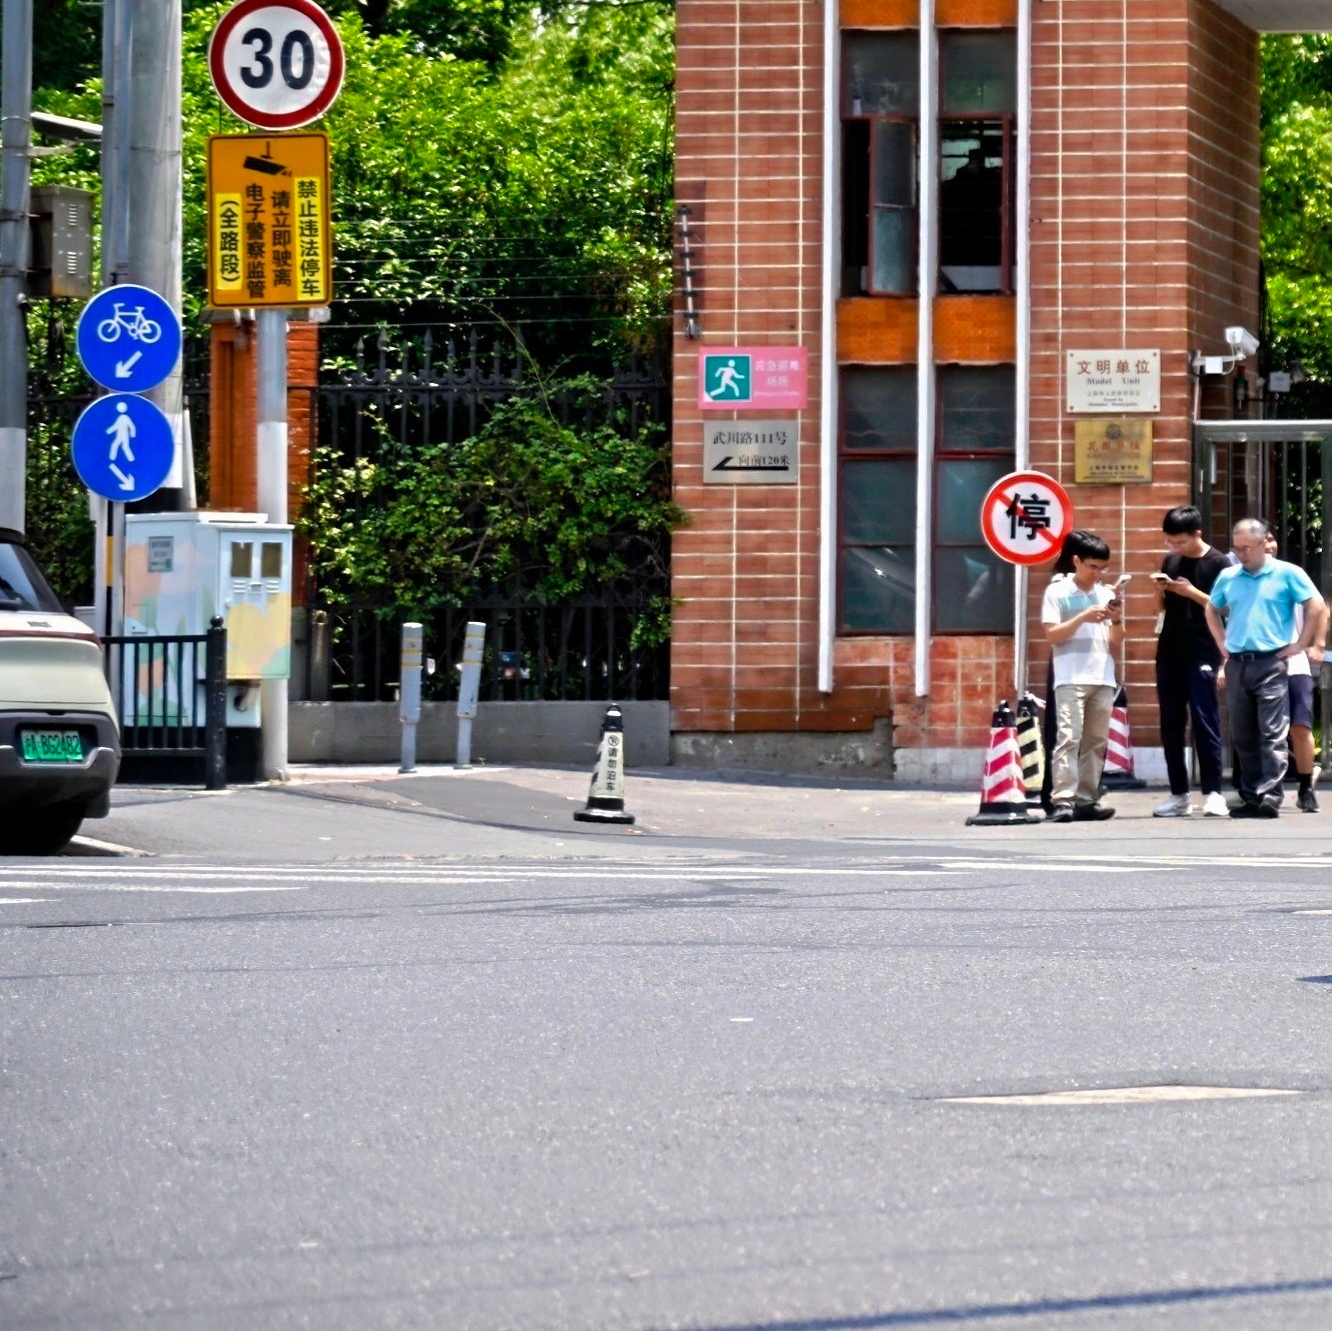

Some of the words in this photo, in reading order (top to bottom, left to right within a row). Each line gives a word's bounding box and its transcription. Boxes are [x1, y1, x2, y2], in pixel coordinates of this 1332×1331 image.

[240, 27, 315, 90] 30
[245, 183, 265, 299] 电子警察监管
[271, 191, 291, 287] 请立即驶离
[298, 179, 320, 296] 禁止违法停车
[1077, 359, 1150, 375] 文明单位
[1087, 377, 1112, 385] Model
[1123, 377, 1141, 385] Unit
[713, 431, 788, 446] 武川路111号
[1006, 492, 1051, 541] 停
